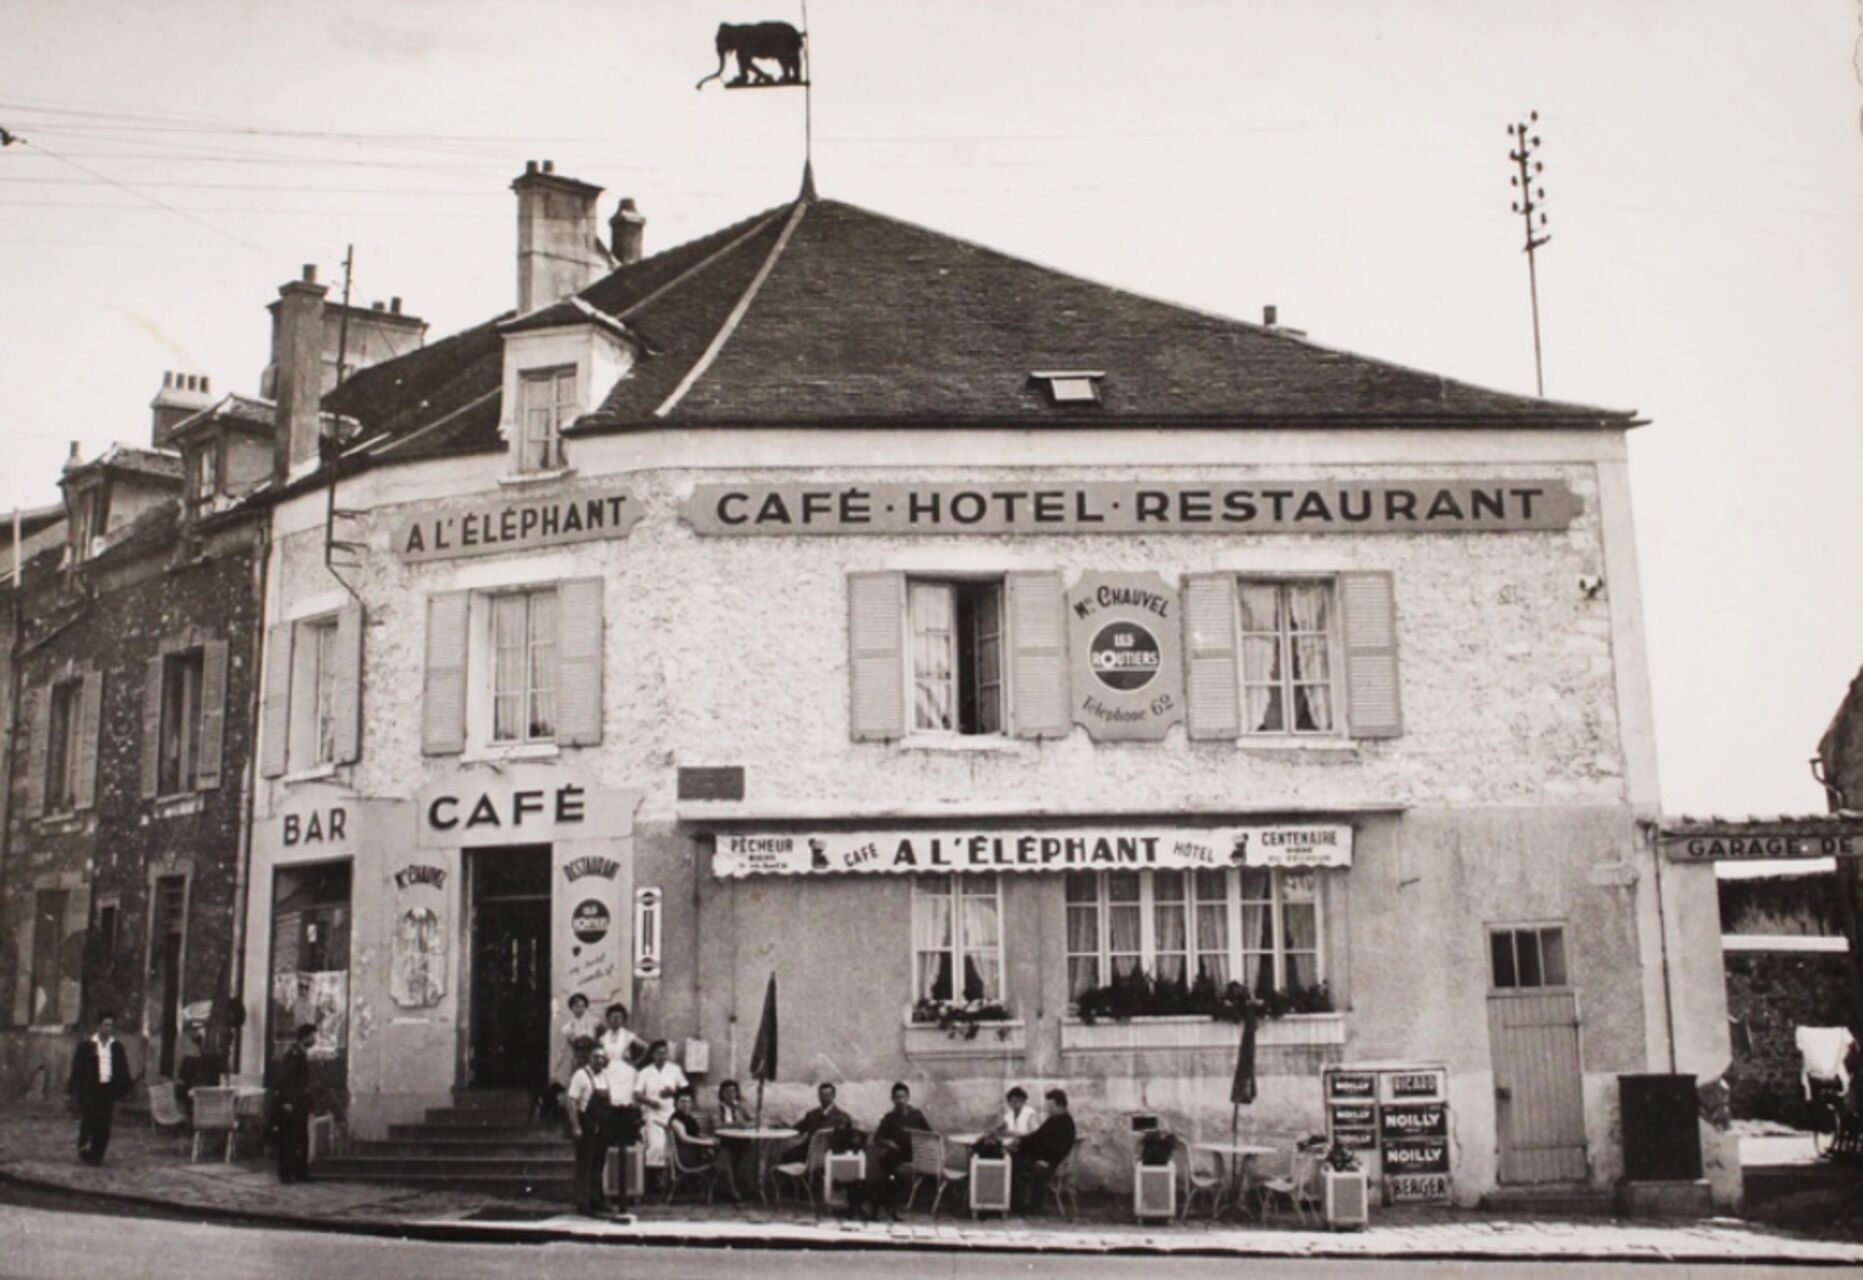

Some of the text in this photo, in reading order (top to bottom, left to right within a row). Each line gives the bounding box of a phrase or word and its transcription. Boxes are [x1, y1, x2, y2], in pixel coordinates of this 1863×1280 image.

[717, 487, 1543, 525] CAFÉ HOTEL RESTAURANT
[405, 496, 627, 553] A L'ÉLÉPHANT
[1151, 693, 1175, 717] 62
[427, 783, 585, 830] CAFÉ
[283, 807, 346, 846] BAR
[1261, 830, 1338, 846] CENTENAIRE
[893, 835, 1160, 866] A L'ÉLÉPHANT
[1687, 836, 1853, 857] GARAGE DE
[1385, 1113, 1441, 1128] NOILLY
[1386, 1149, 1442, 1163] NOILLY
